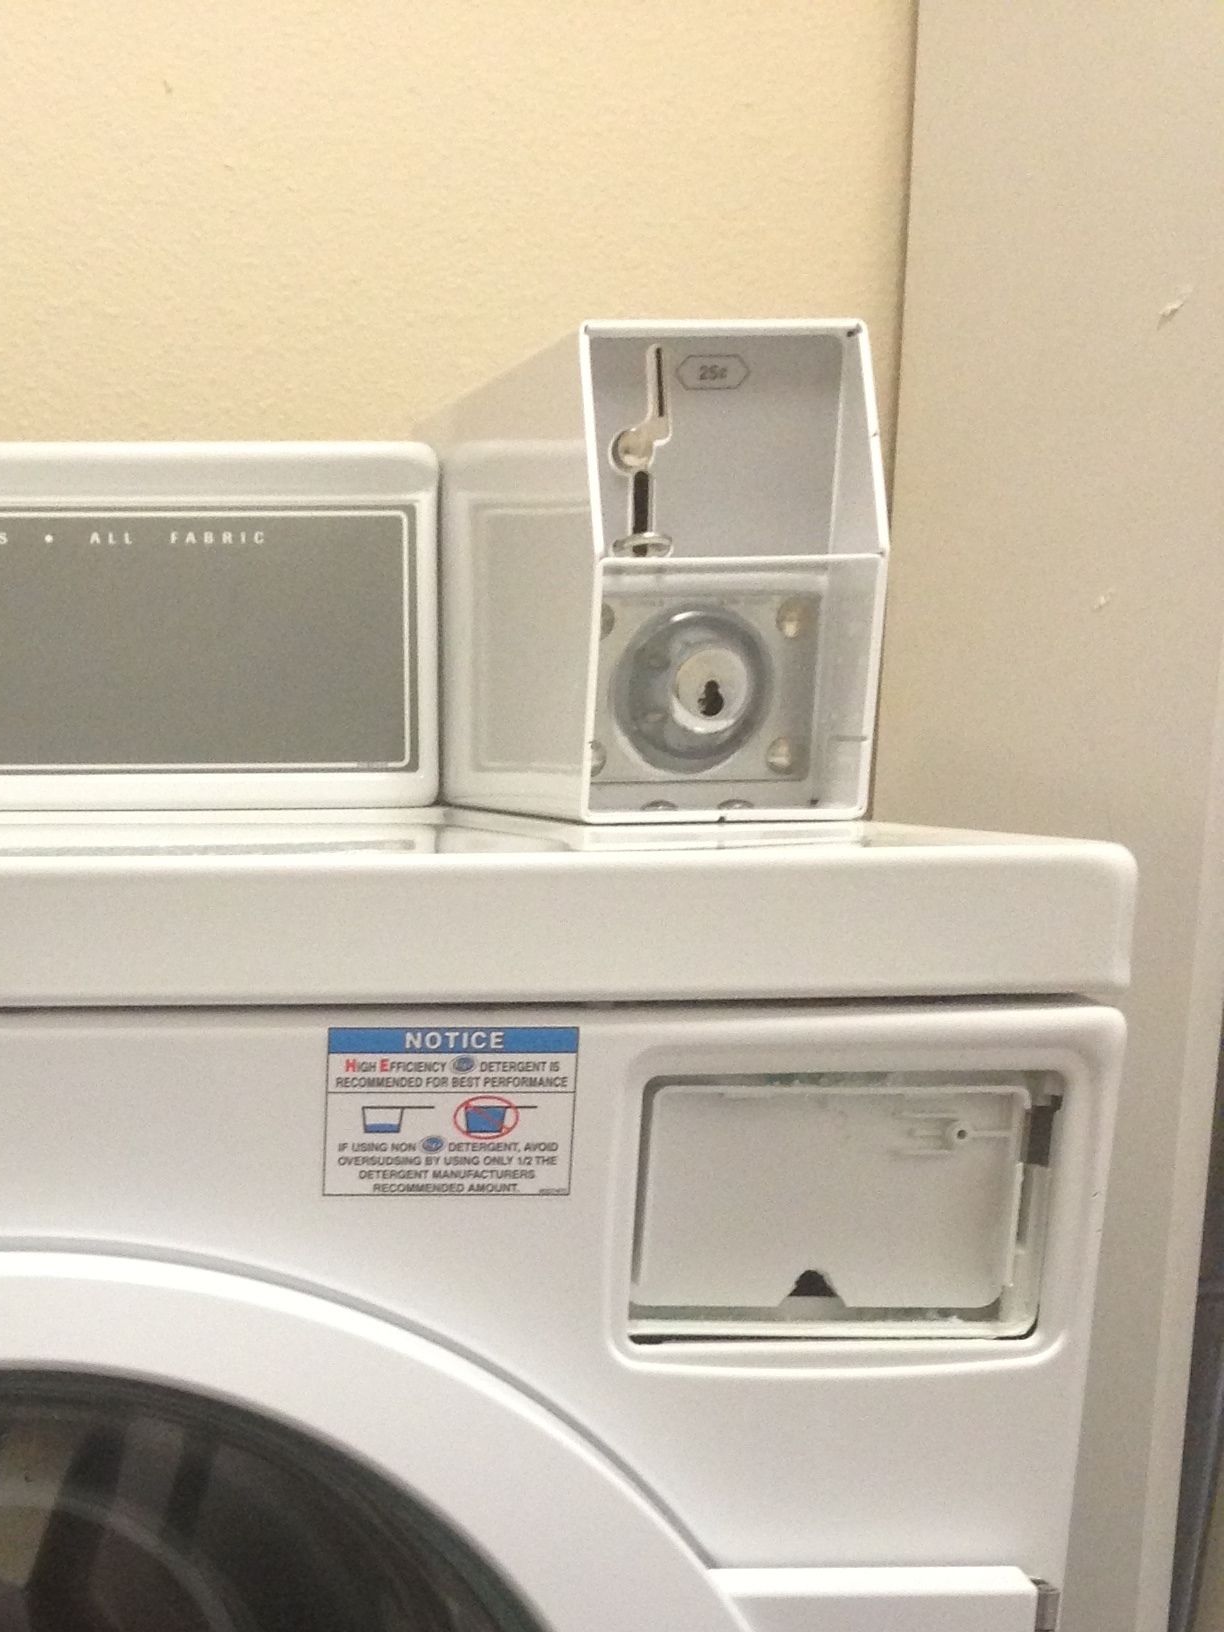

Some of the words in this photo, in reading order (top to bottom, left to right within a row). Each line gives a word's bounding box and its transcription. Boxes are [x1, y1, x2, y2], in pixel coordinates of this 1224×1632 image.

[89, 531, 133, 545] ALL
[169, 530, 265, 545] FABRIC
[404, 1031, 505, 1050] NOTICE
[478, 1060, 548, 1073] DETERGENT
[548, 1060, 561, 1073] IS
[335, 1076, 424, 1089] RECOMMENDED
[425, 1076, 449, 1089] FOR
[450, 1076, 482, 1089] BEST
[482, 1075, 569, 1088] PERFORMANCE
[337, 1142, 349, 1153] IF
[350, 1142, 389, 1153] USING
[390, 1141, 417, 1153] NON
[447, 1141, 522, 1153] DETERGENT,
[523, 1141, 559, 1153] AVOID
[423, 1155, 441, 1167] BY
[443, 1155, 481, 1167] USING
[482, 1155, 515, 1167] ONLY
[517, 1155, 534, 1166] 1/2
[534, 1155, 559, 1166] THE
[358, 1169, 430, 1180] DETERGENT
[431, 1169, 536, 1180] MANUFACTURERS
[372, 1182, 466, 1195] RECOMMENDED
[467, 1182, 521, 1194] AMOUNT.
